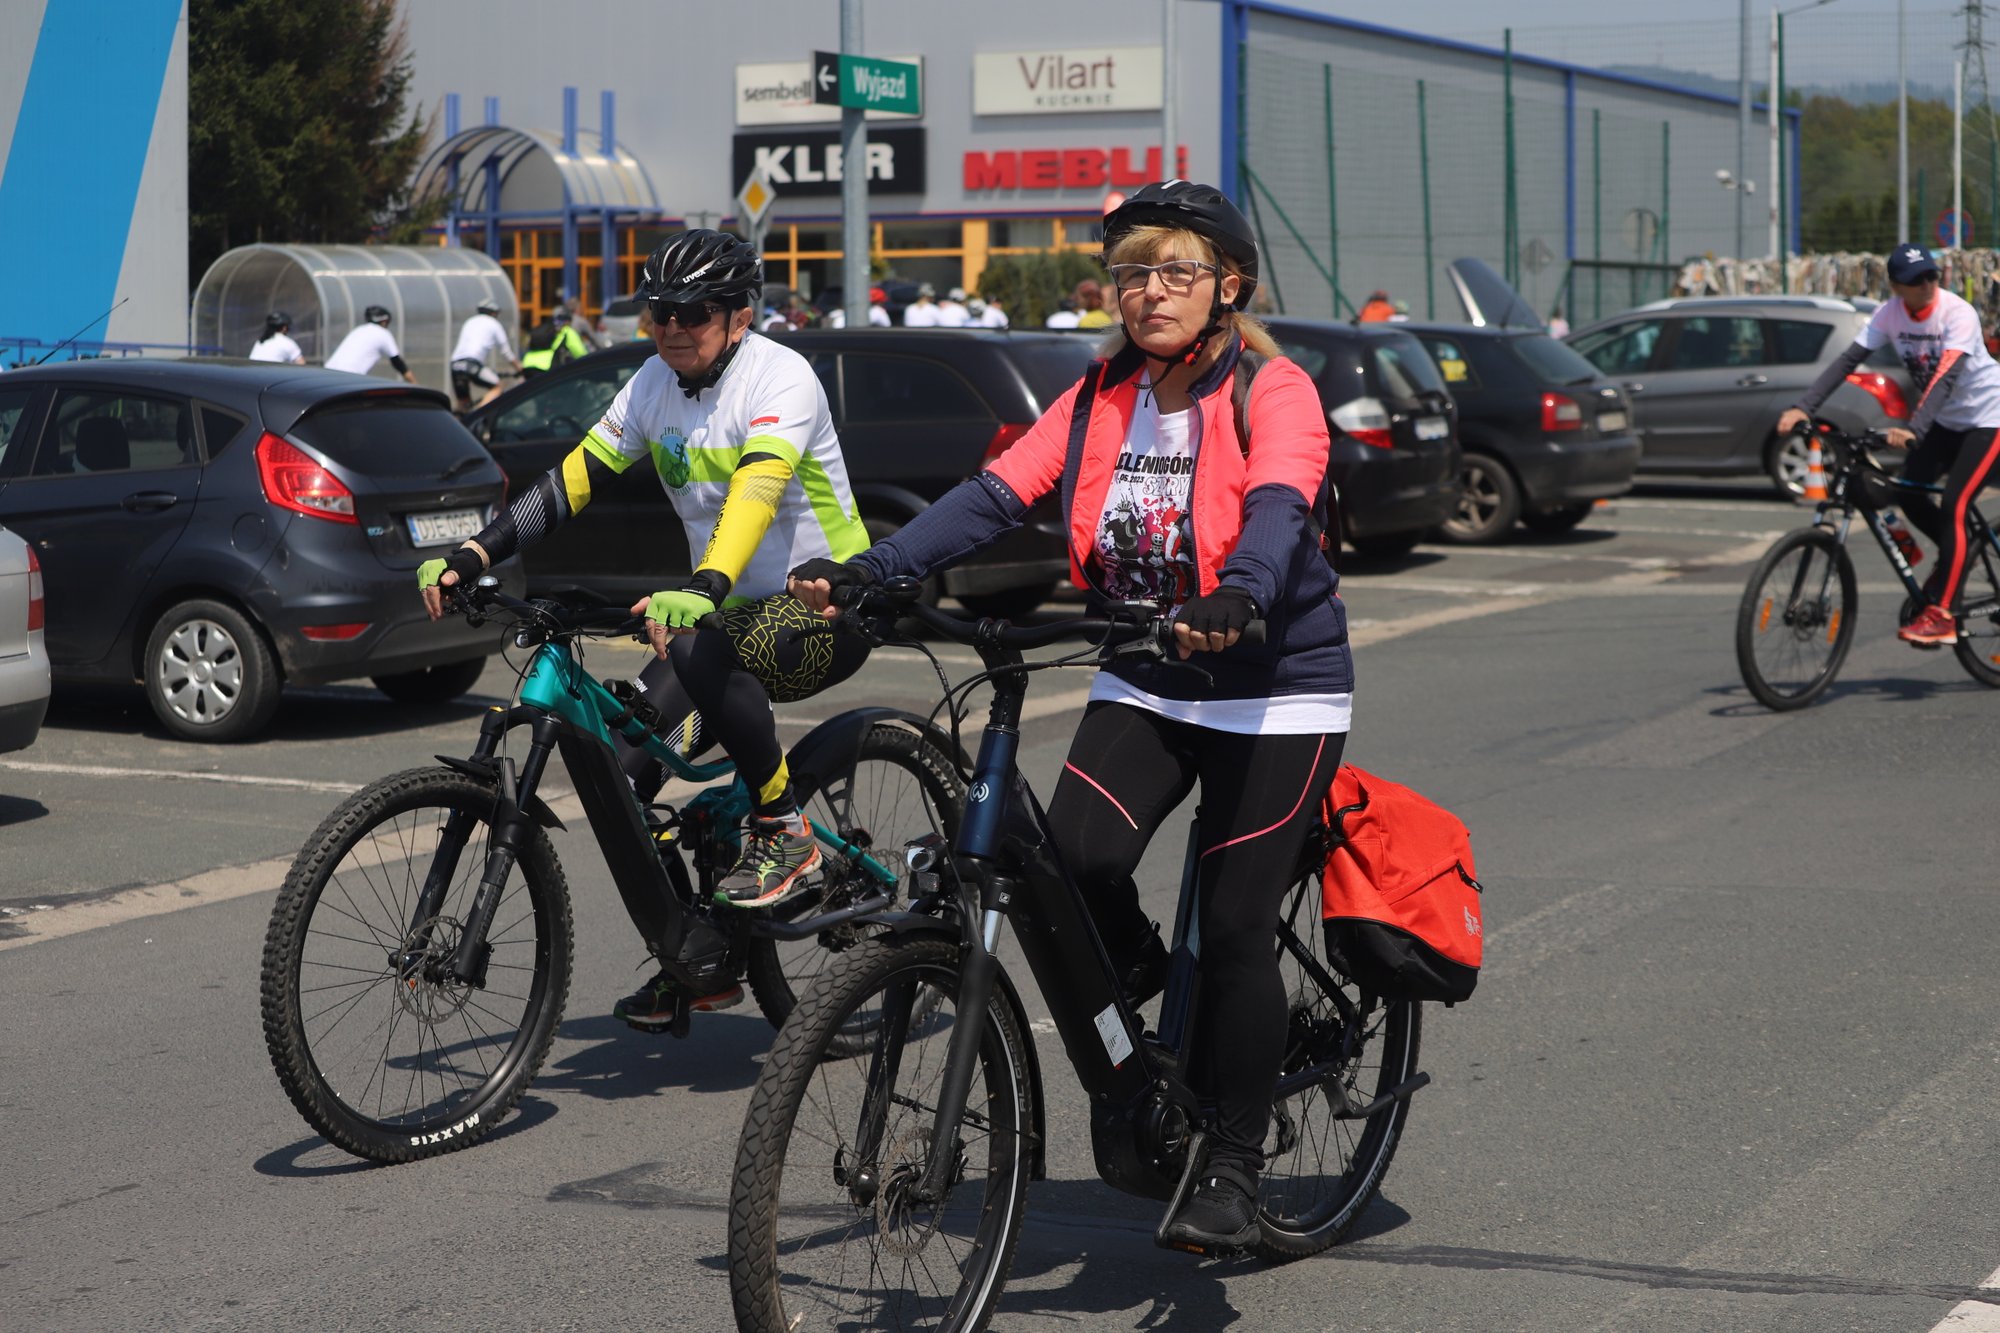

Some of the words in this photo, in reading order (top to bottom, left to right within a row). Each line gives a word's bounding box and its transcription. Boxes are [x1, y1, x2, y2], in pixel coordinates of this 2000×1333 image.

[852, 65, 907, 102] Wyjazd
[1018, 56, 1116, 90] Vilart
[1035, 93, 1113, 106] KUCHNIE
[755, 142, 895, 183] KLER
[682, 268, 707, 284] uvex
[410, 1112, 480, 1146] MAXXIS
